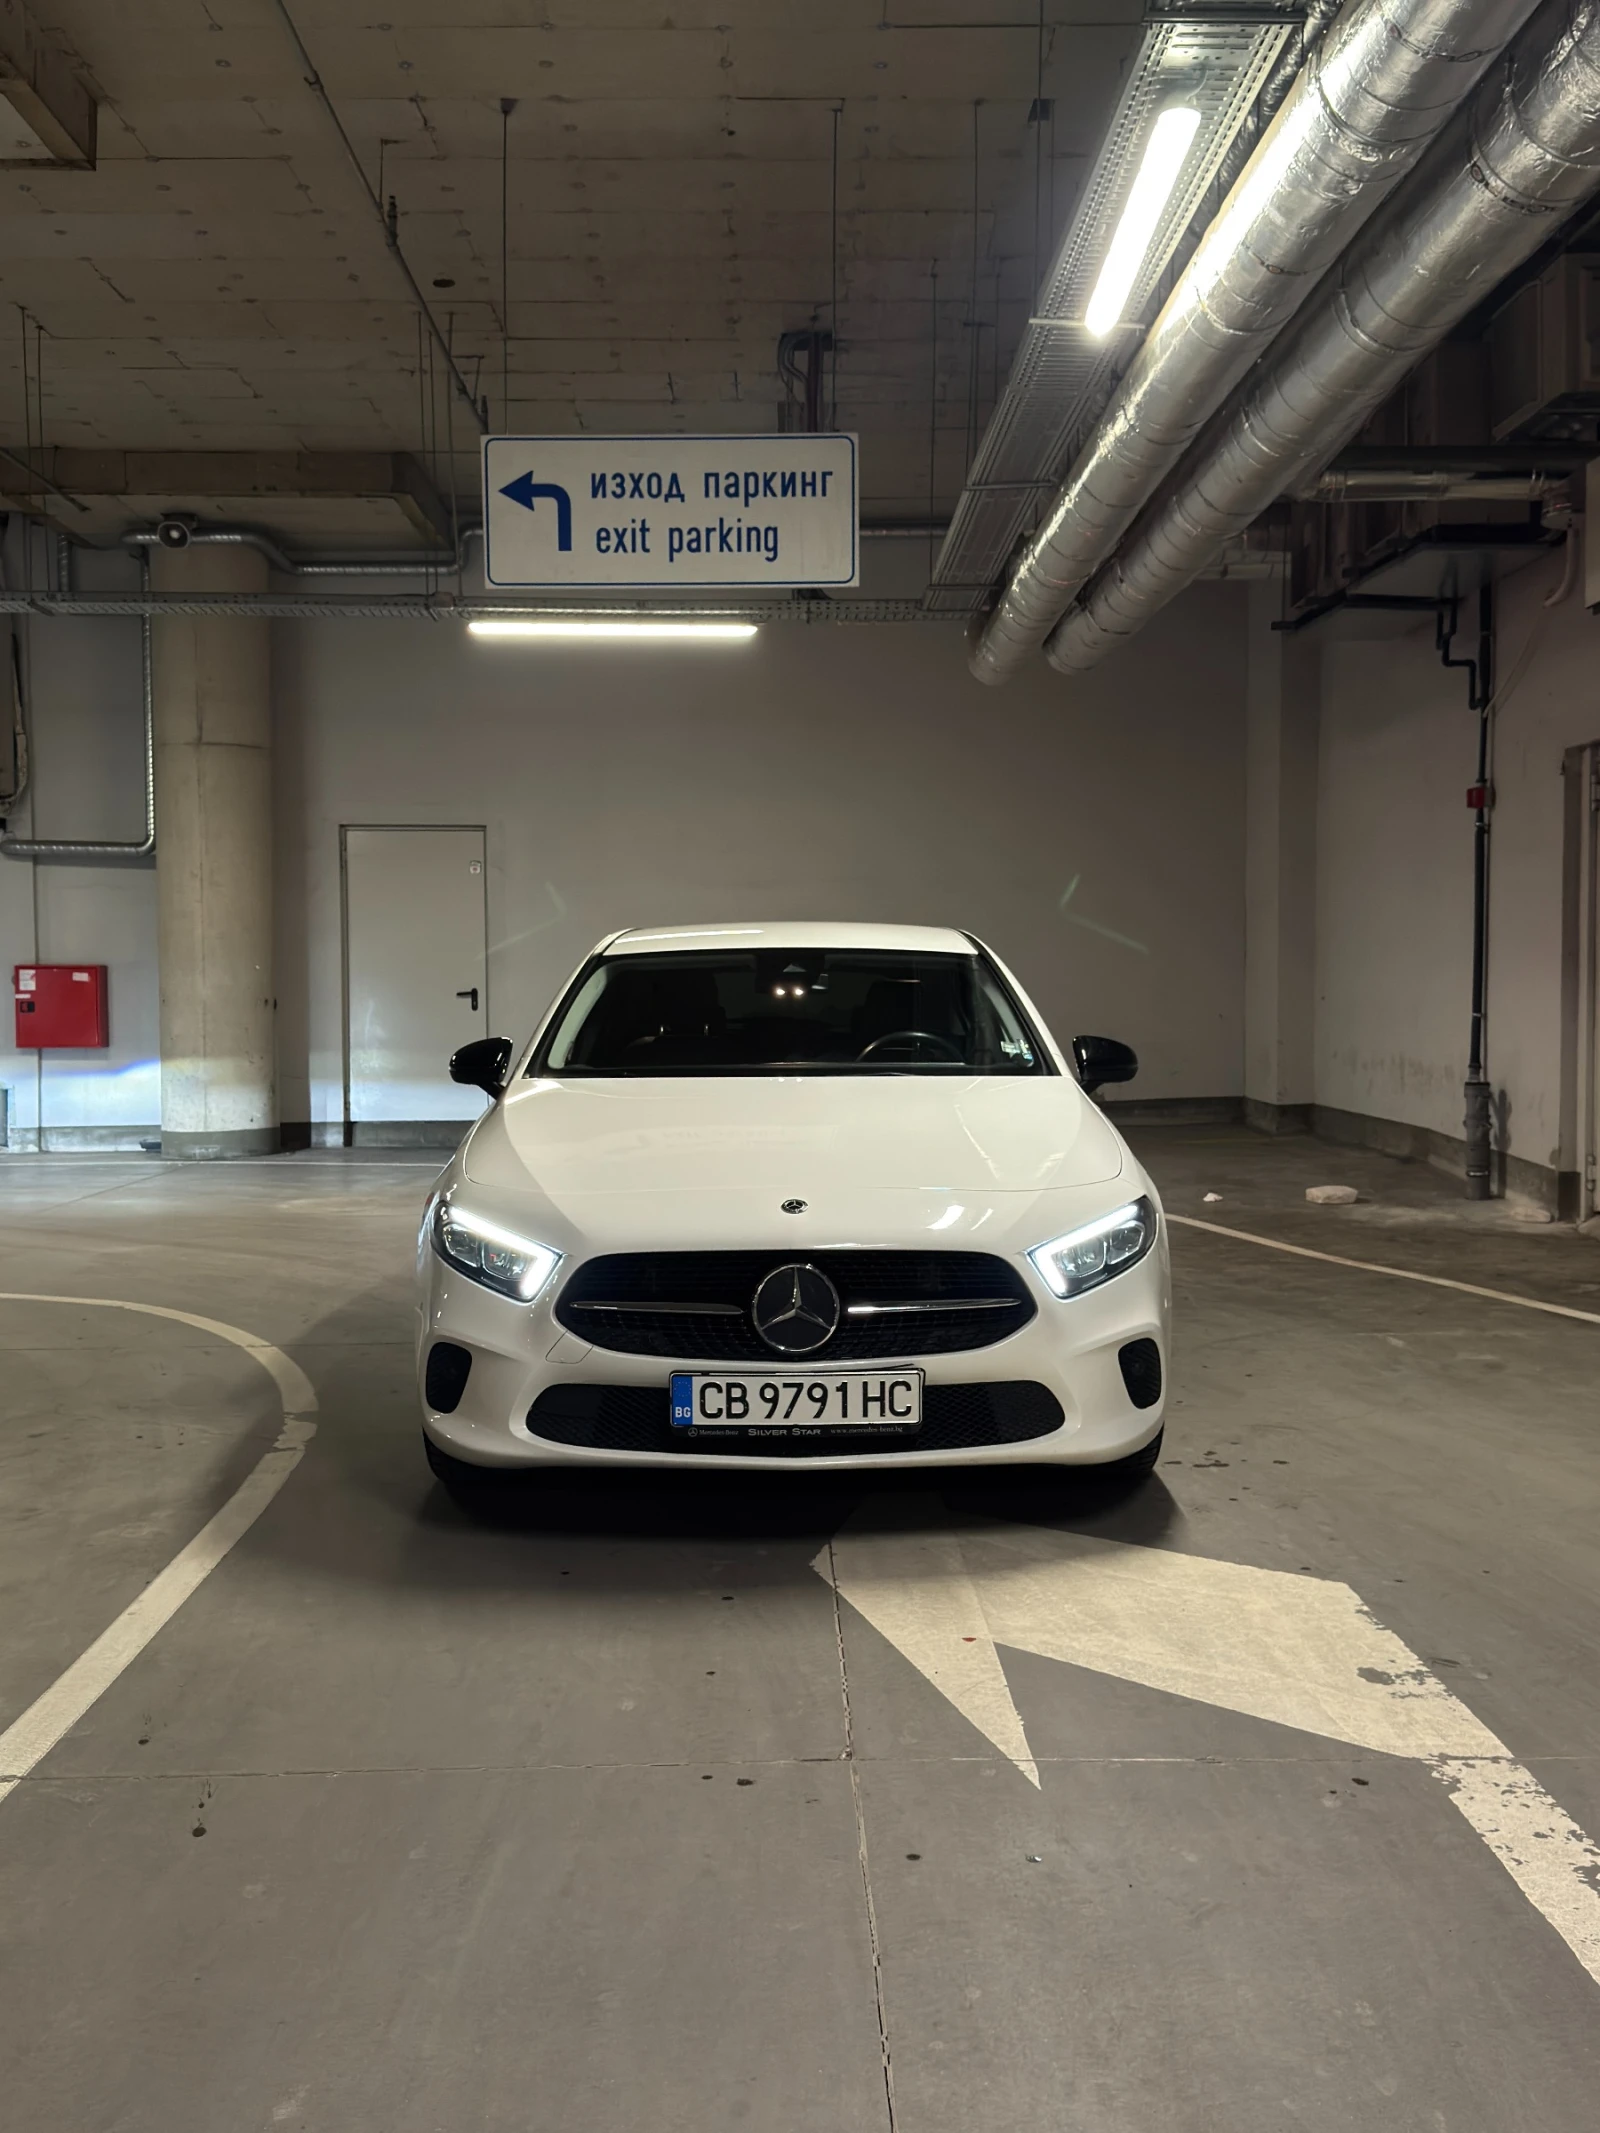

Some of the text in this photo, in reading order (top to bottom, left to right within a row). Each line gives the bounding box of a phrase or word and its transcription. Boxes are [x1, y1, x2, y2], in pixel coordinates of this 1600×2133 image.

[591, 471, 833, 508] изход паркинг
[596, 517, 778, 563] exit parking
[675, 1407, 691, 1418] BG
[699, 1380, 912, 1419] CB 9791 HC
